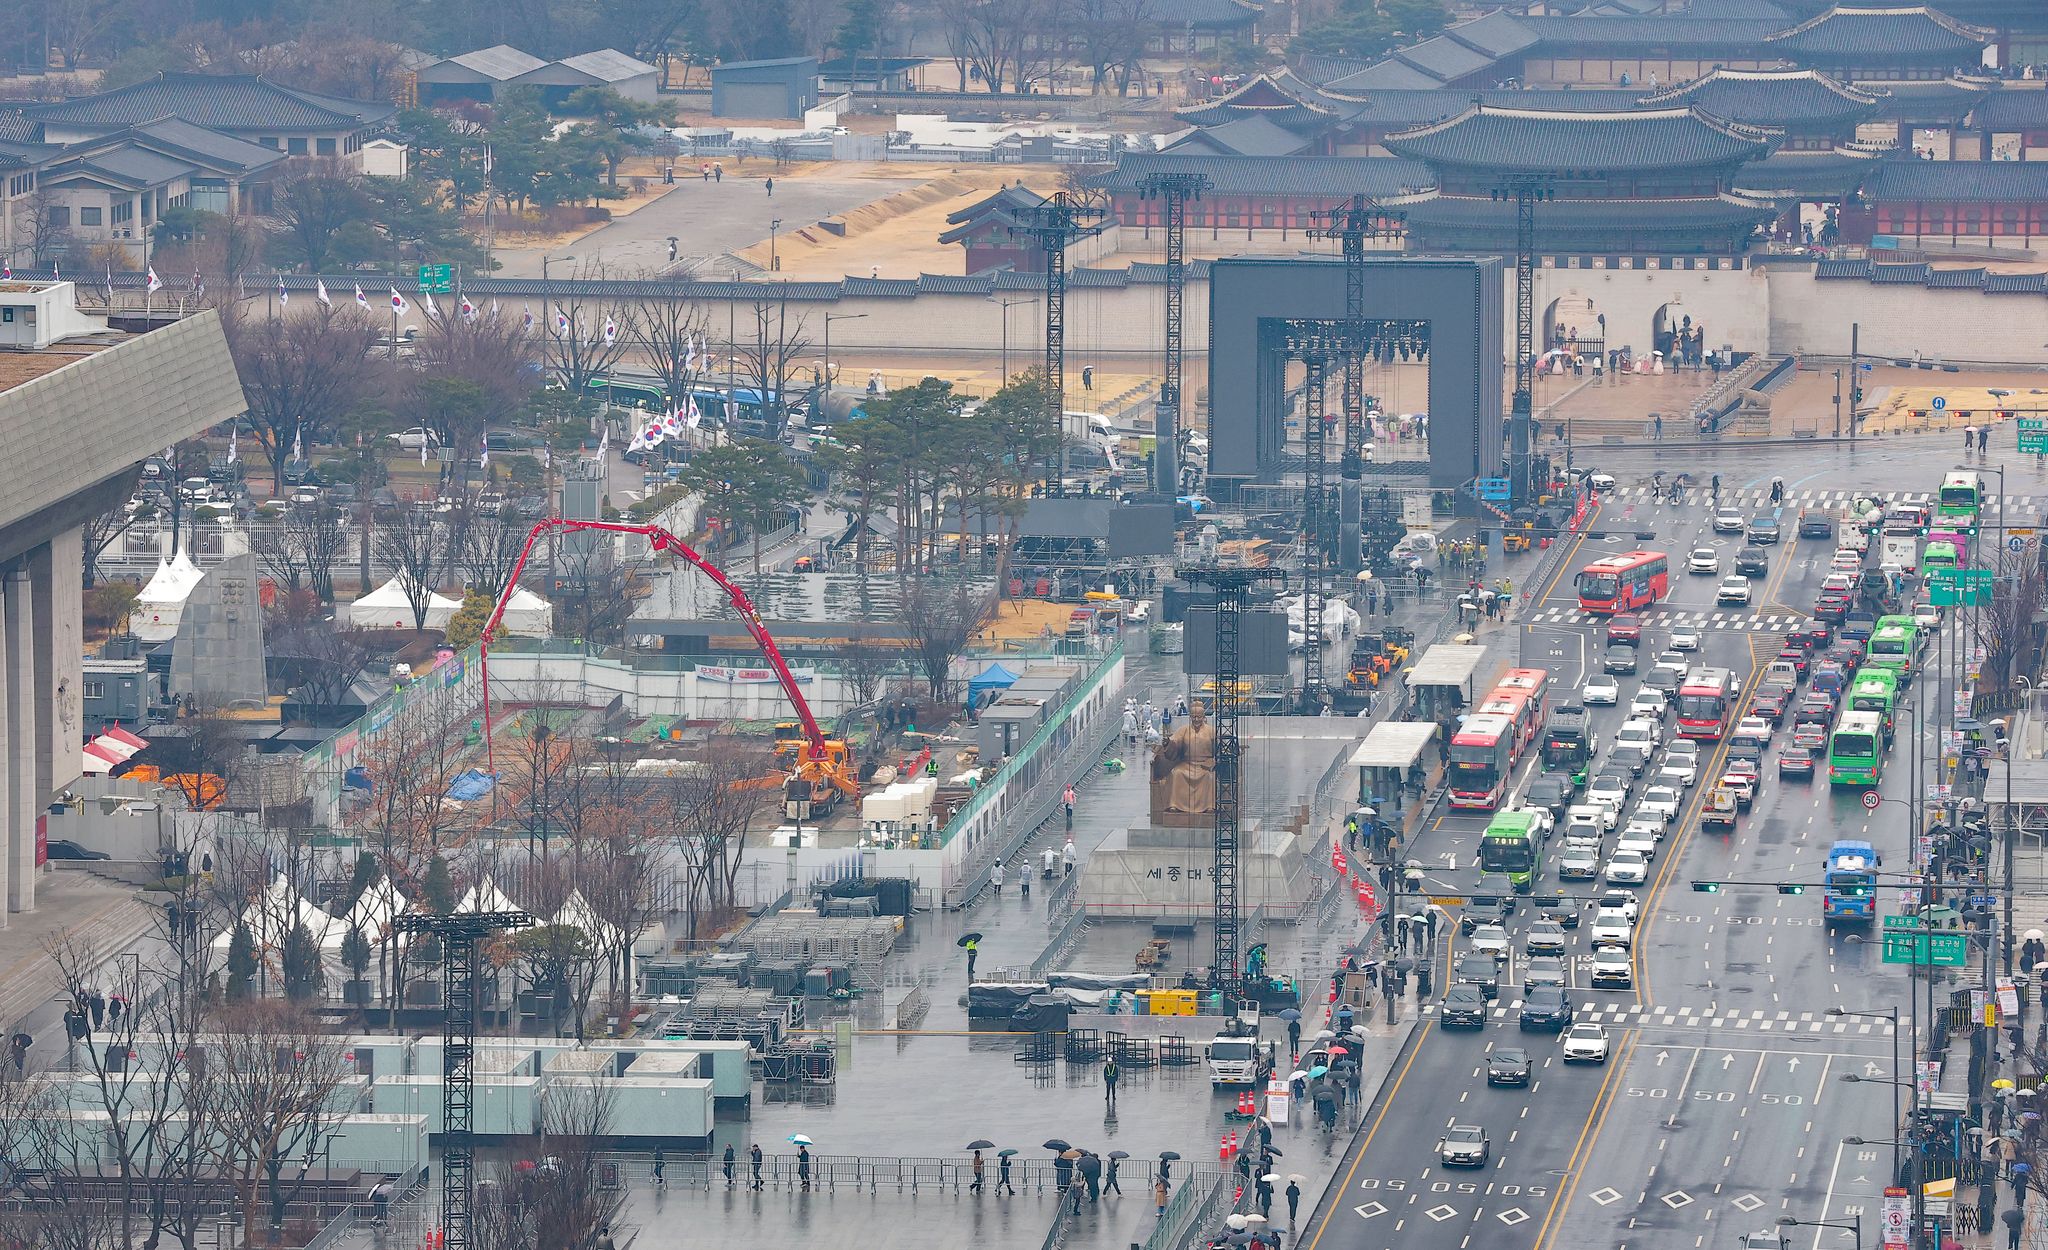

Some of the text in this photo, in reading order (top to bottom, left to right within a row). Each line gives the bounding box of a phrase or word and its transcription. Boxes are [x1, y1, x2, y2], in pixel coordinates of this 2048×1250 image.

[555, 580, 563, 591] P
[1866, 795, 1876, 804] 50
[1665, 914, 1824, 926] 50 50 50
[1627, 1087, 1803, 1105] 50 50 50
[1360, 1179, 1547, 1197] 50 50 50
